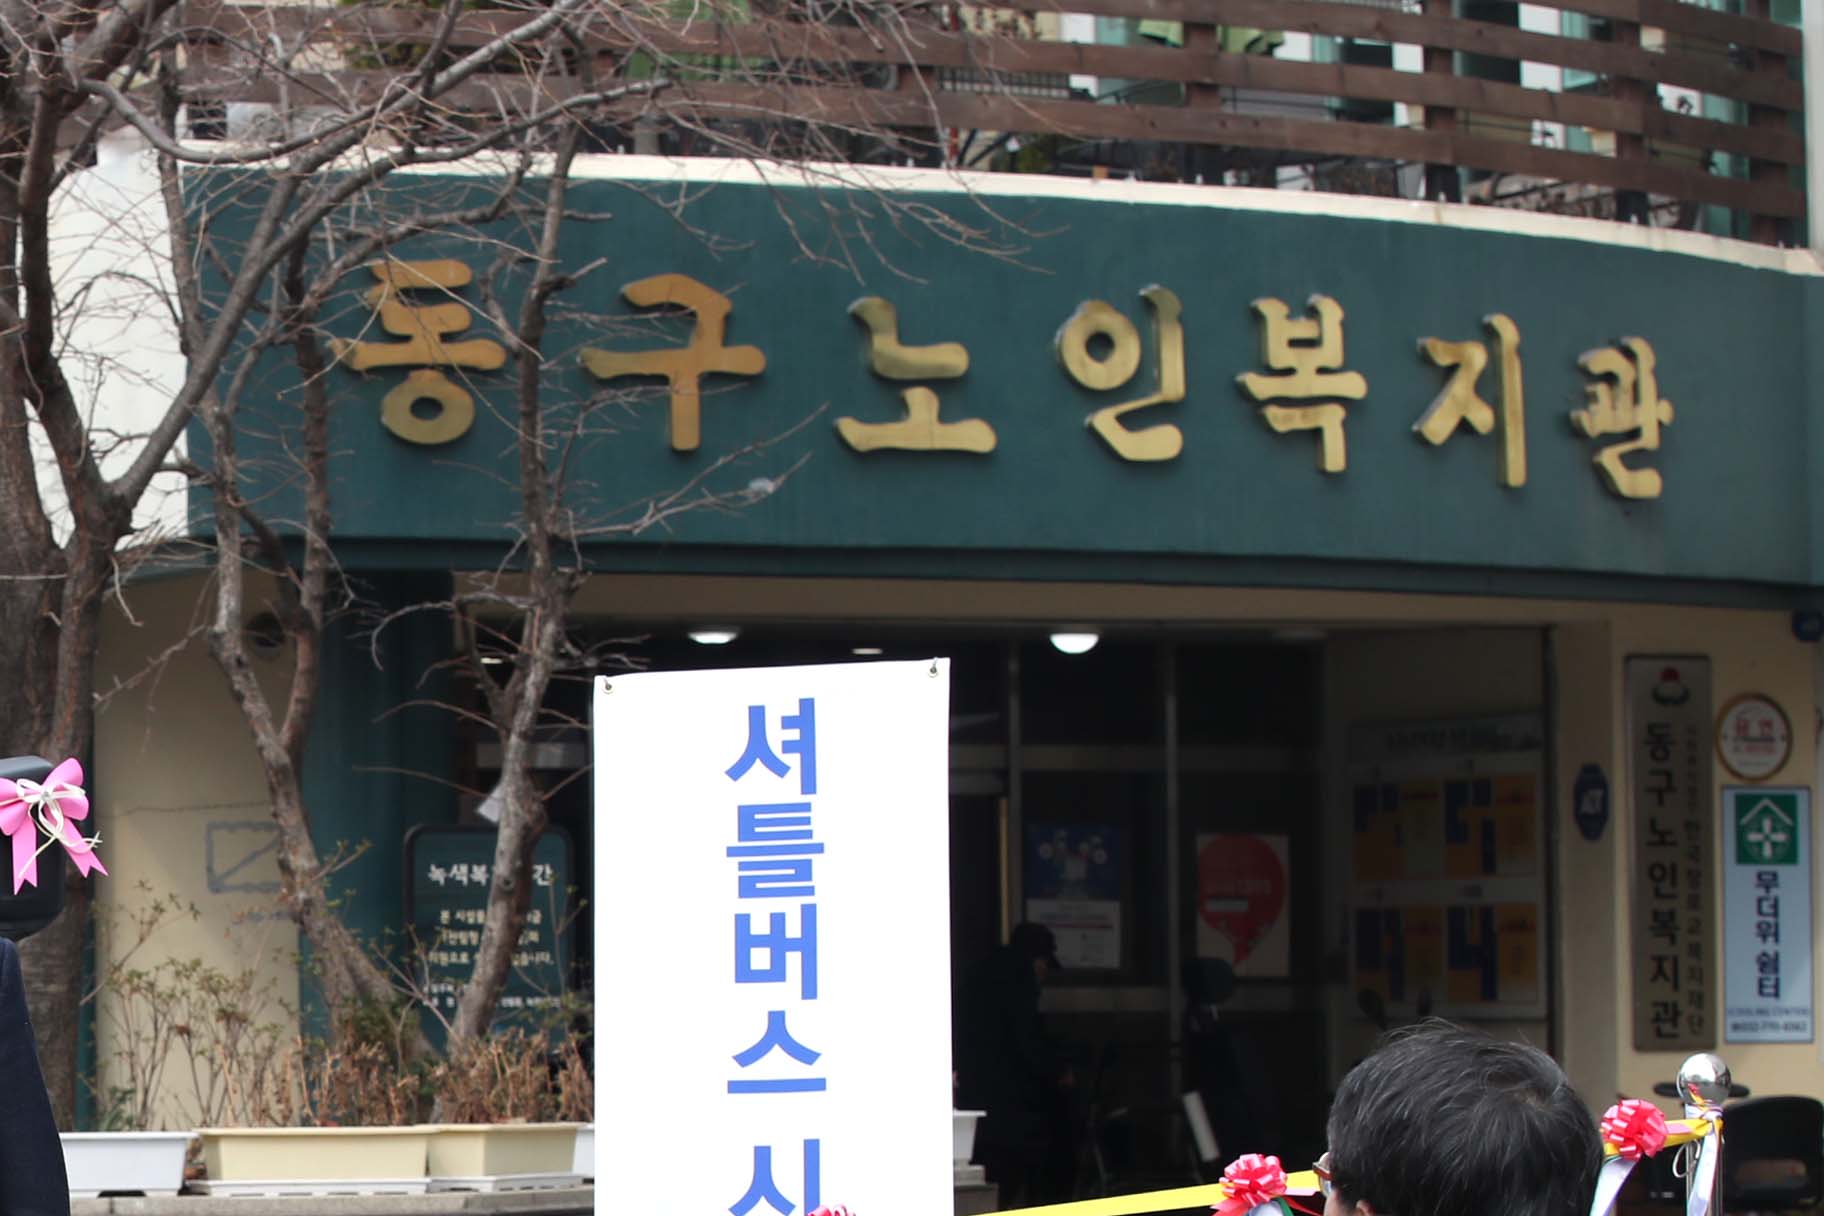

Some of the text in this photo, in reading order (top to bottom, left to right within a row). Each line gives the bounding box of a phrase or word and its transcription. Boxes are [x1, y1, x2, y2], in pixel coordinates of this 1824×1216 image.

[428, 862, 554, 887] 녹색복간
[724, 697, 827, 1095] 셔틀버스
[1643, 721, 1683, 1040] 동구노인복지관
[1754, 870, 1781, 945] 무더위
